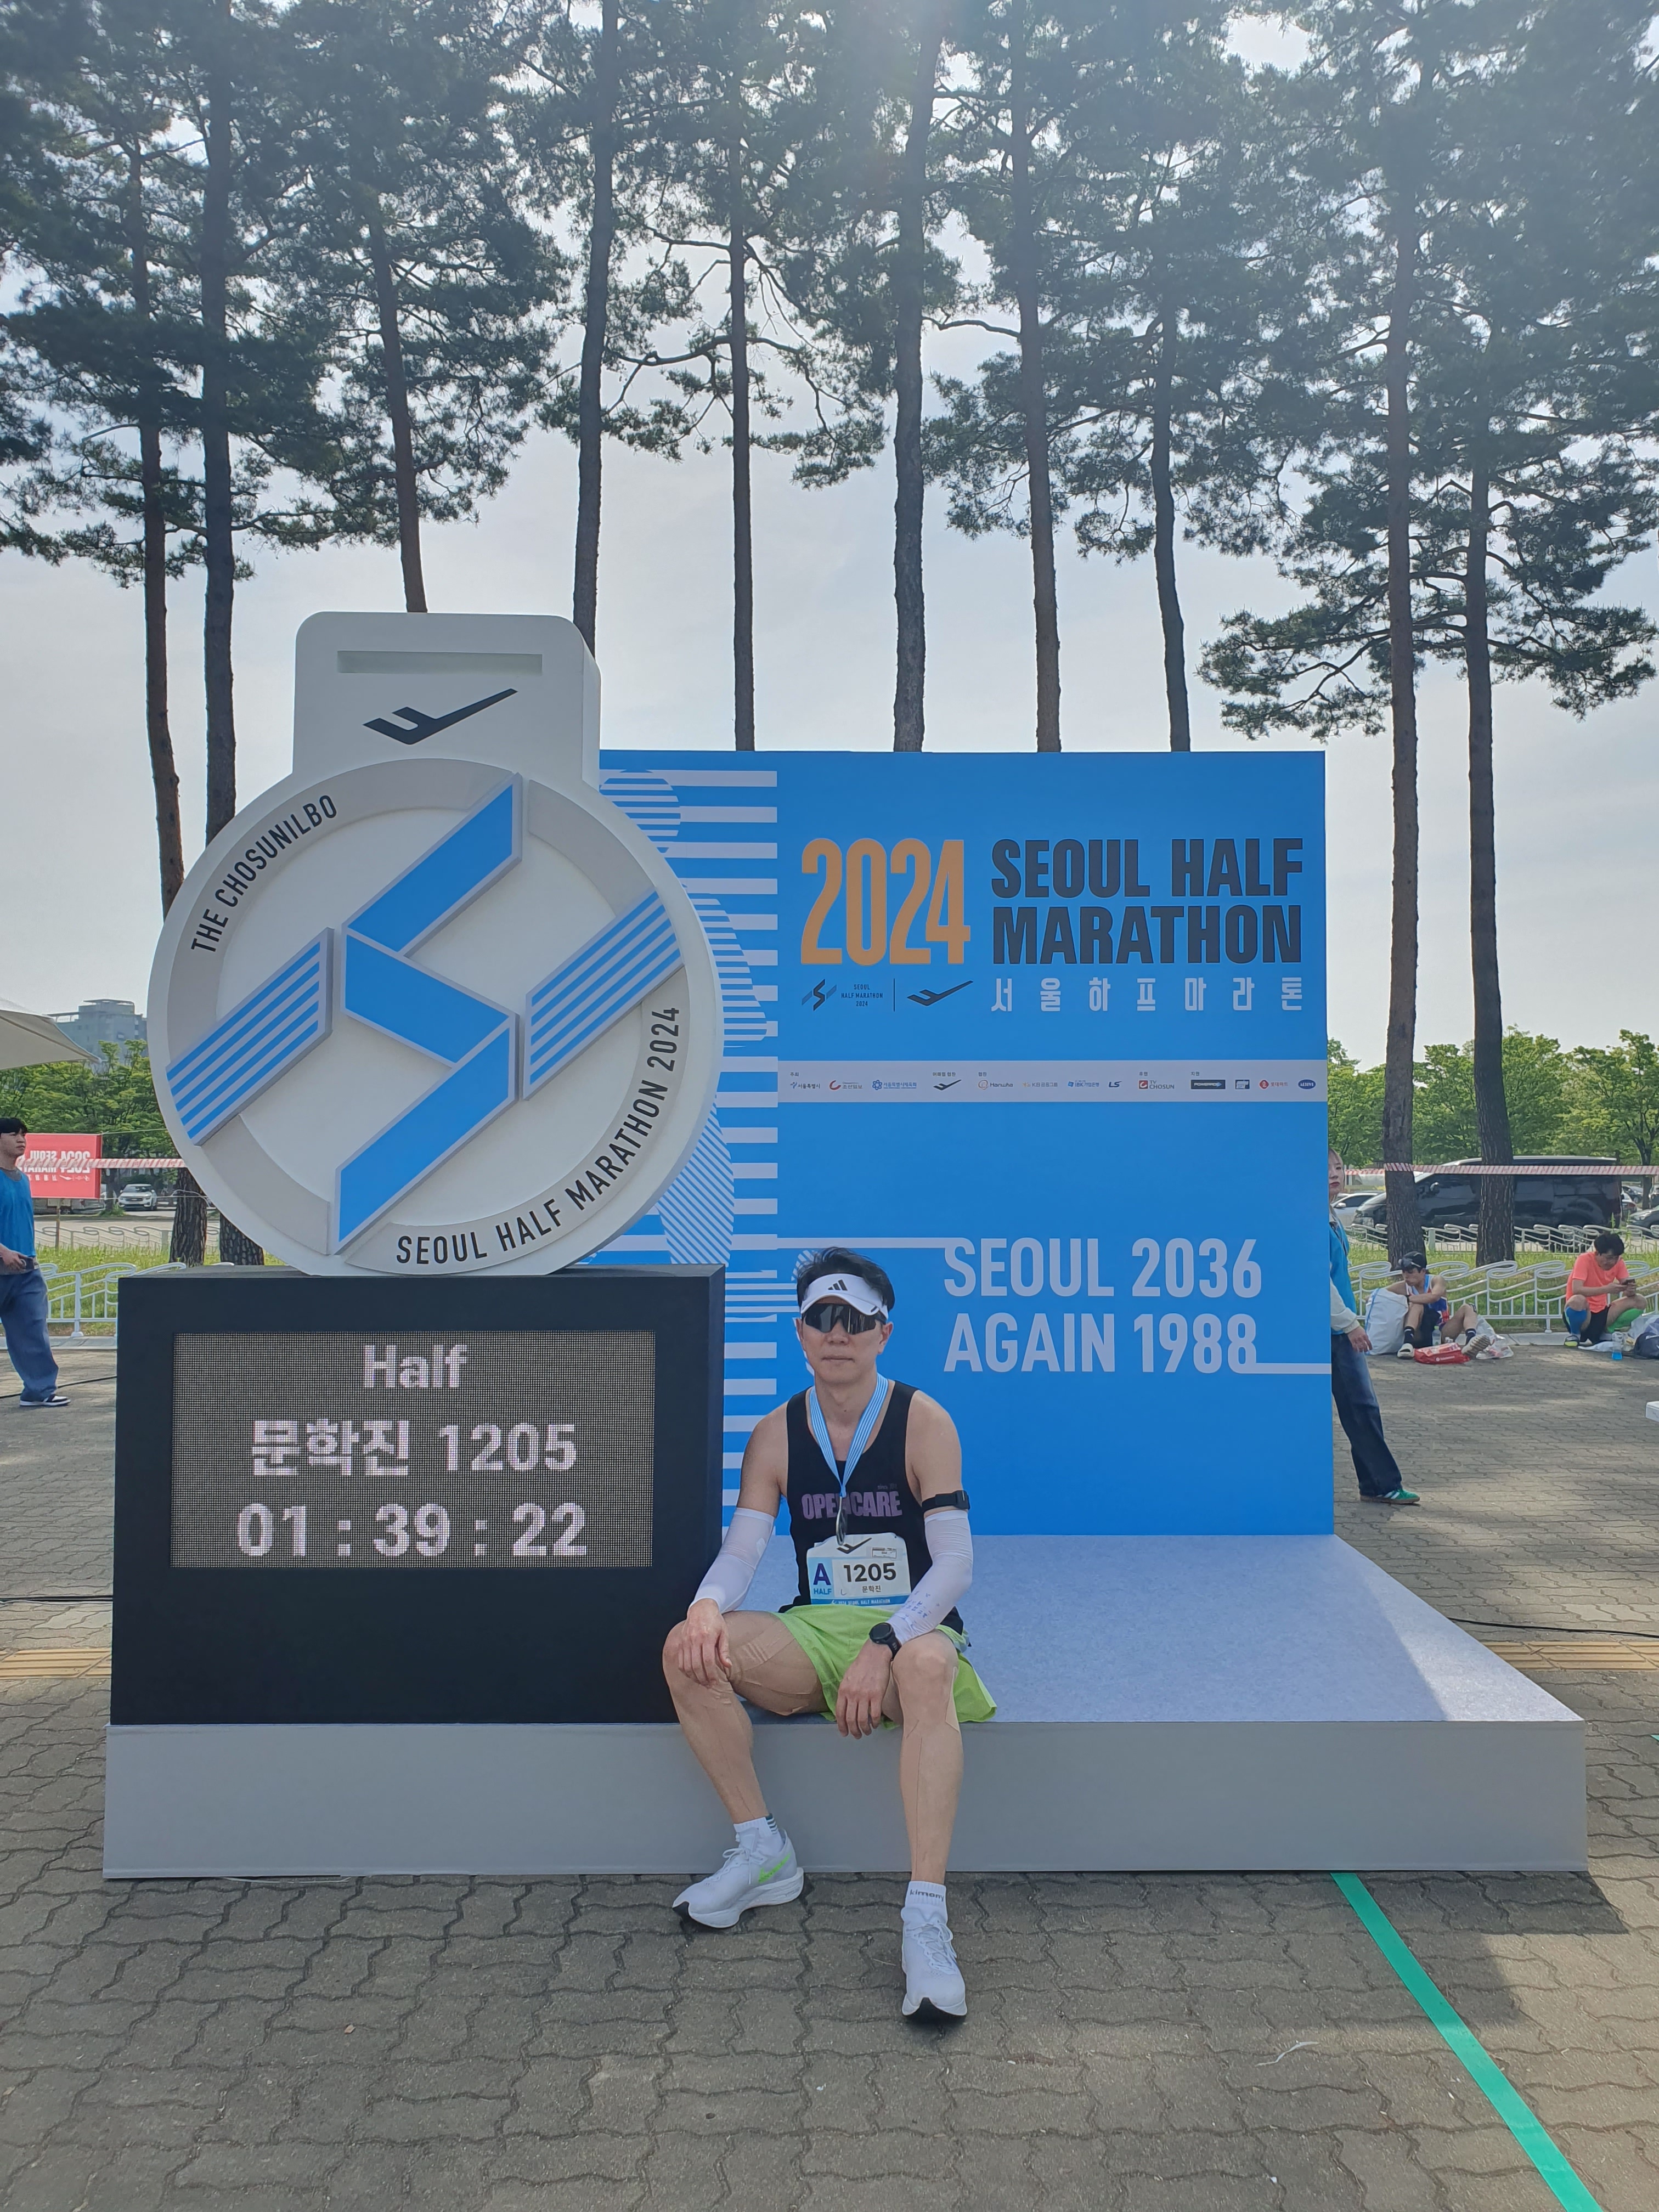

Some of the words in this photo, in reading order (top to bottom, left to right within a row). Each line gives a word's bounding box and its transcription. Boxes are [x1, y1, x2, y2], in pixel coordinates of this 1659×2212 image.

[190, 909, 229, 952] THE
[215, 795, 337, 907] CHOSUNILBO
[991, 838, 1150, 899] SEOUL
[1171, 838, 1304, 897] HALF
[800, 838, 971, 967] 2024
[992, 905, 1302, 964] MARATHON
[396, 1232, 488, 1265] SEOUL
[495, 1199, 561, 1252] HALF
[565, 1079, 668, 1211] MARATHON
[647, 1007, 680, 1072] 2024
[944, 1238, 1114, 1297] SEOUL
[1132, 1238, 1261, 1298] 2036
[363, 1344, 467, 1388] Half
[944, 1313, 1115, 1372] AGAIN
[1133, 1313, 1257, 1374] 1988
[251, 1418, 409, 1476] 문학진
[439, 1424, 577, 1471] 1205
[236, 1503, 308, 1556] 01
[373, 1503, 451, 1556] 39
[512, 1503, 588, 1556] 22
[813, 1563, 831, 1585] A
[843, 1562, 896, 1582] 1205
[862, 1585, 881, 1593] 문학진
[910, 1889, 944, 1902] kimony
